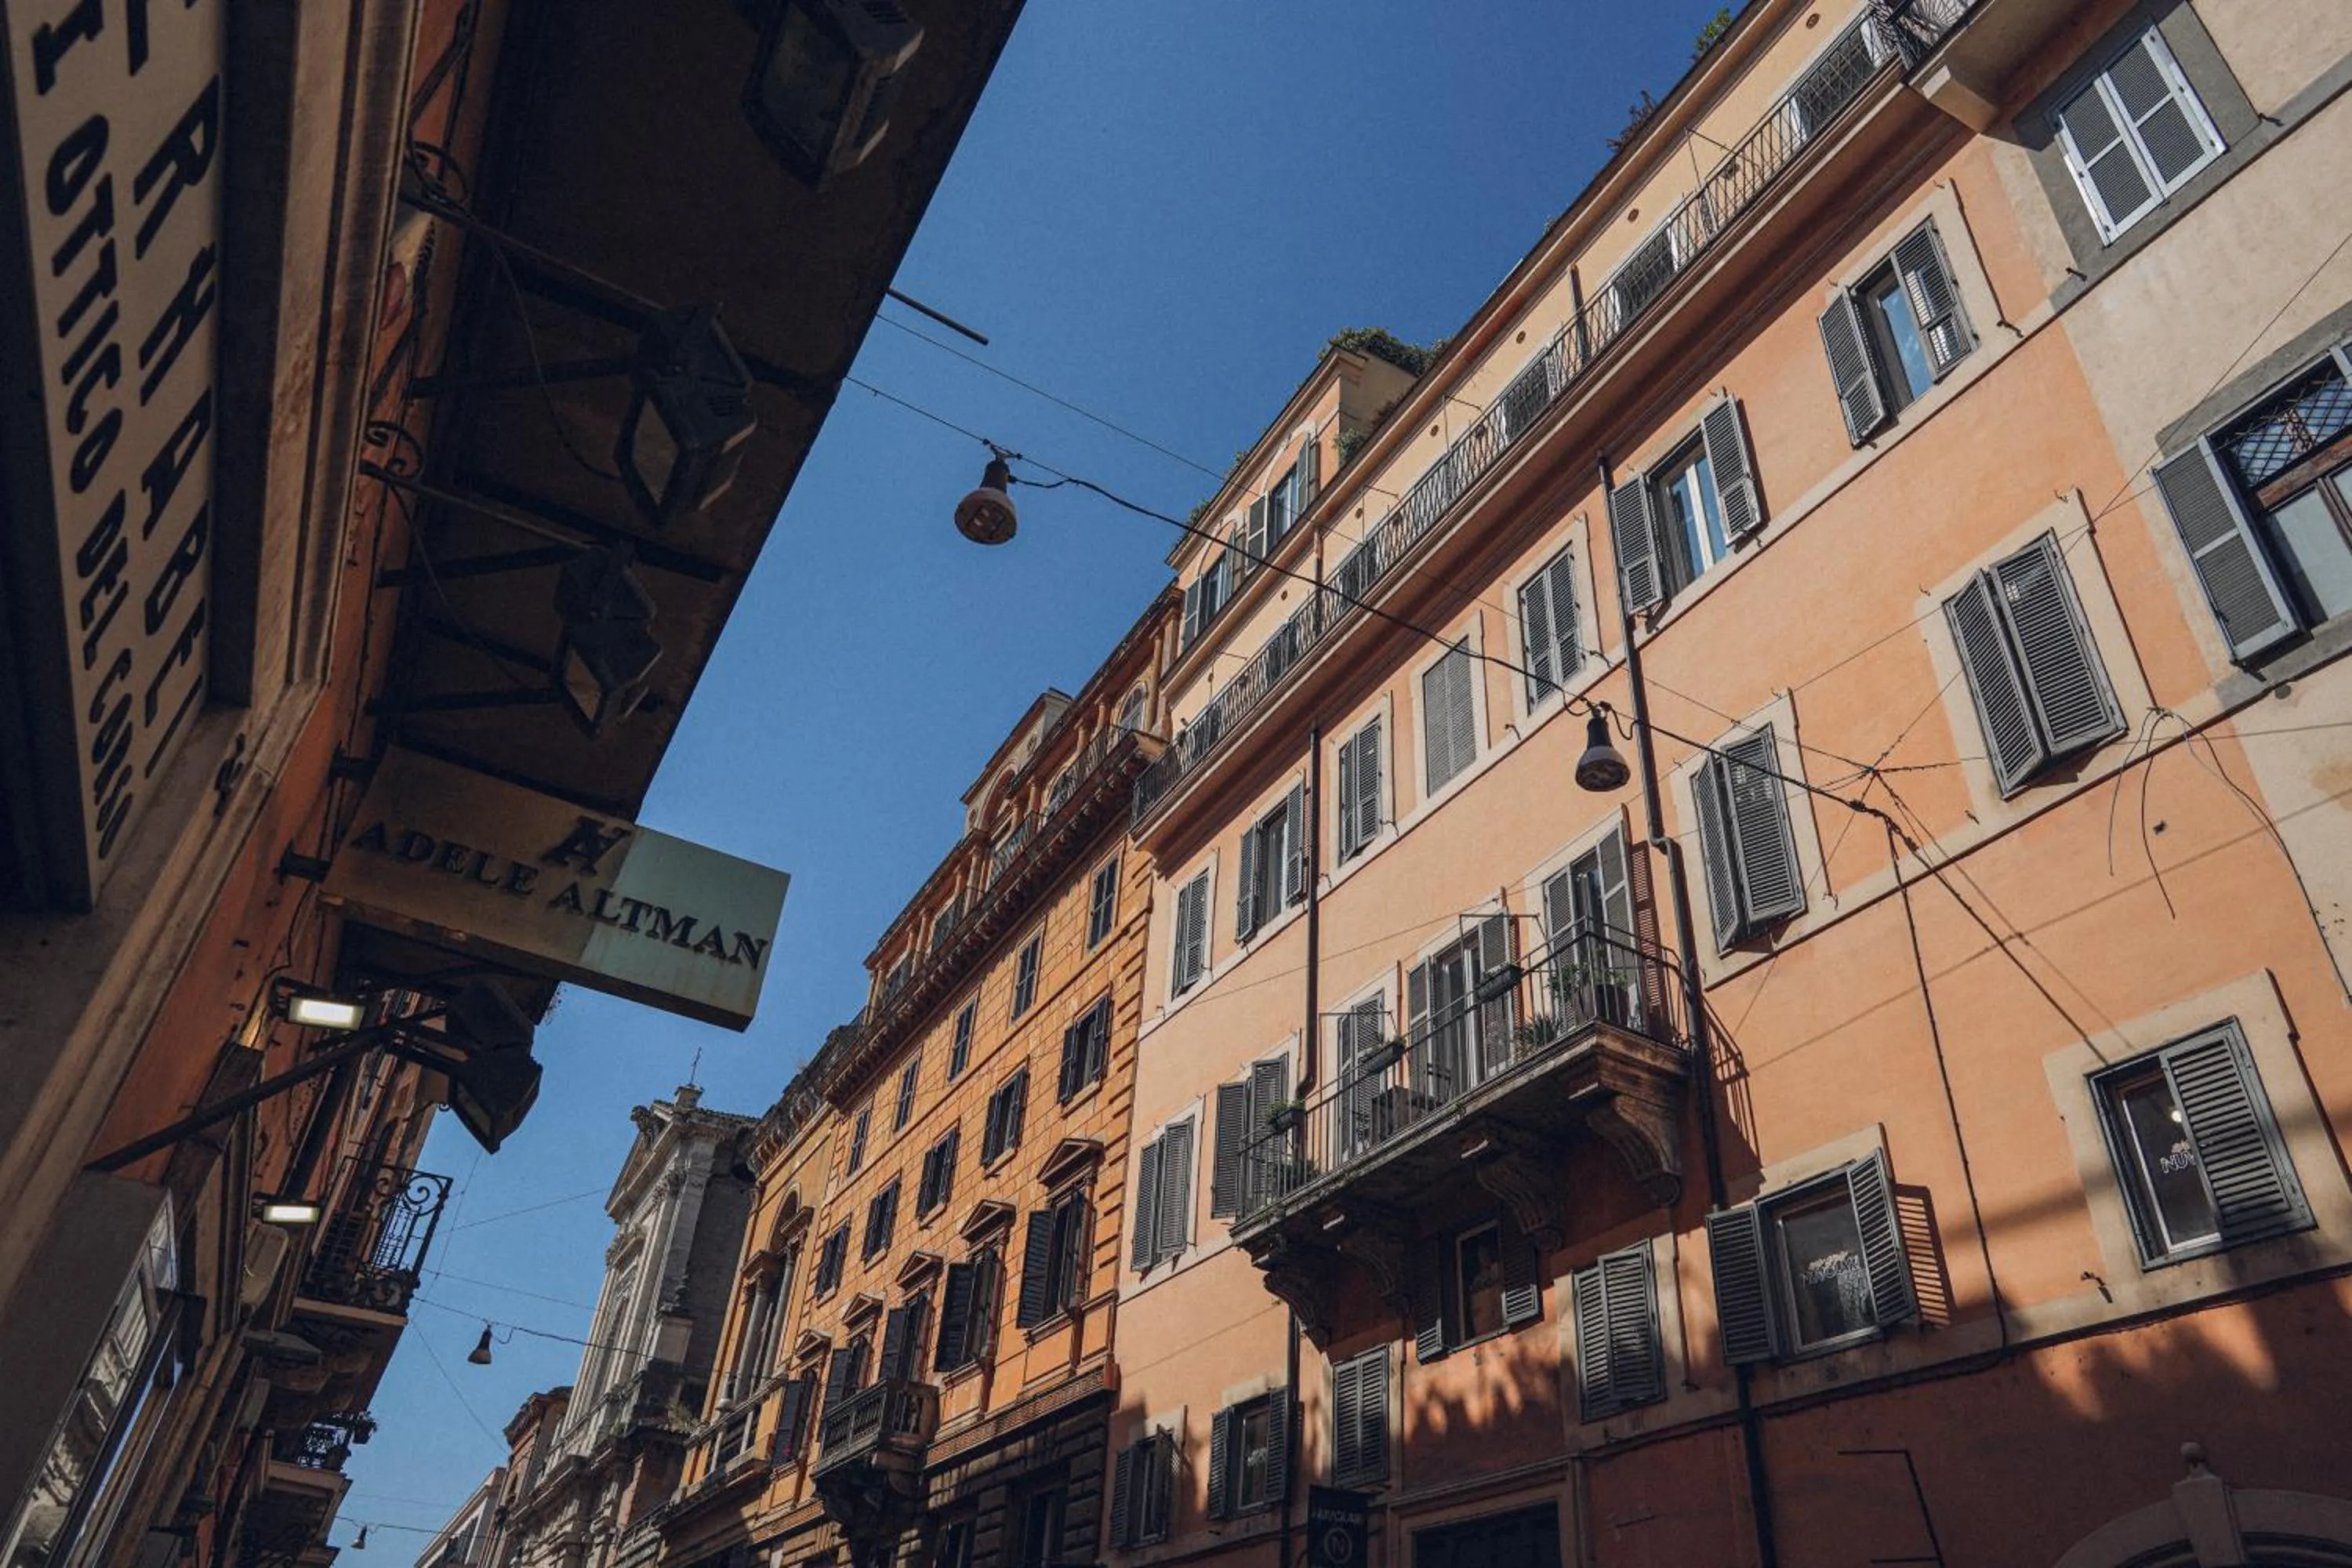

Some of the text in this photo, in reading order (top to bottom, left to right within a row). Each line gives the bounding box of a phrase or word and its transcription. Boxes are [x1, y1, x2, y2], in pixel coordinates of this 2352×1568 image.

[46, 114, 122, 493] OTTICO
[77, 488, 129, 670] DEL
[89, 648, 132, 859] CORSO
[350, 821, 769, 971] ADELE ALTMAN
